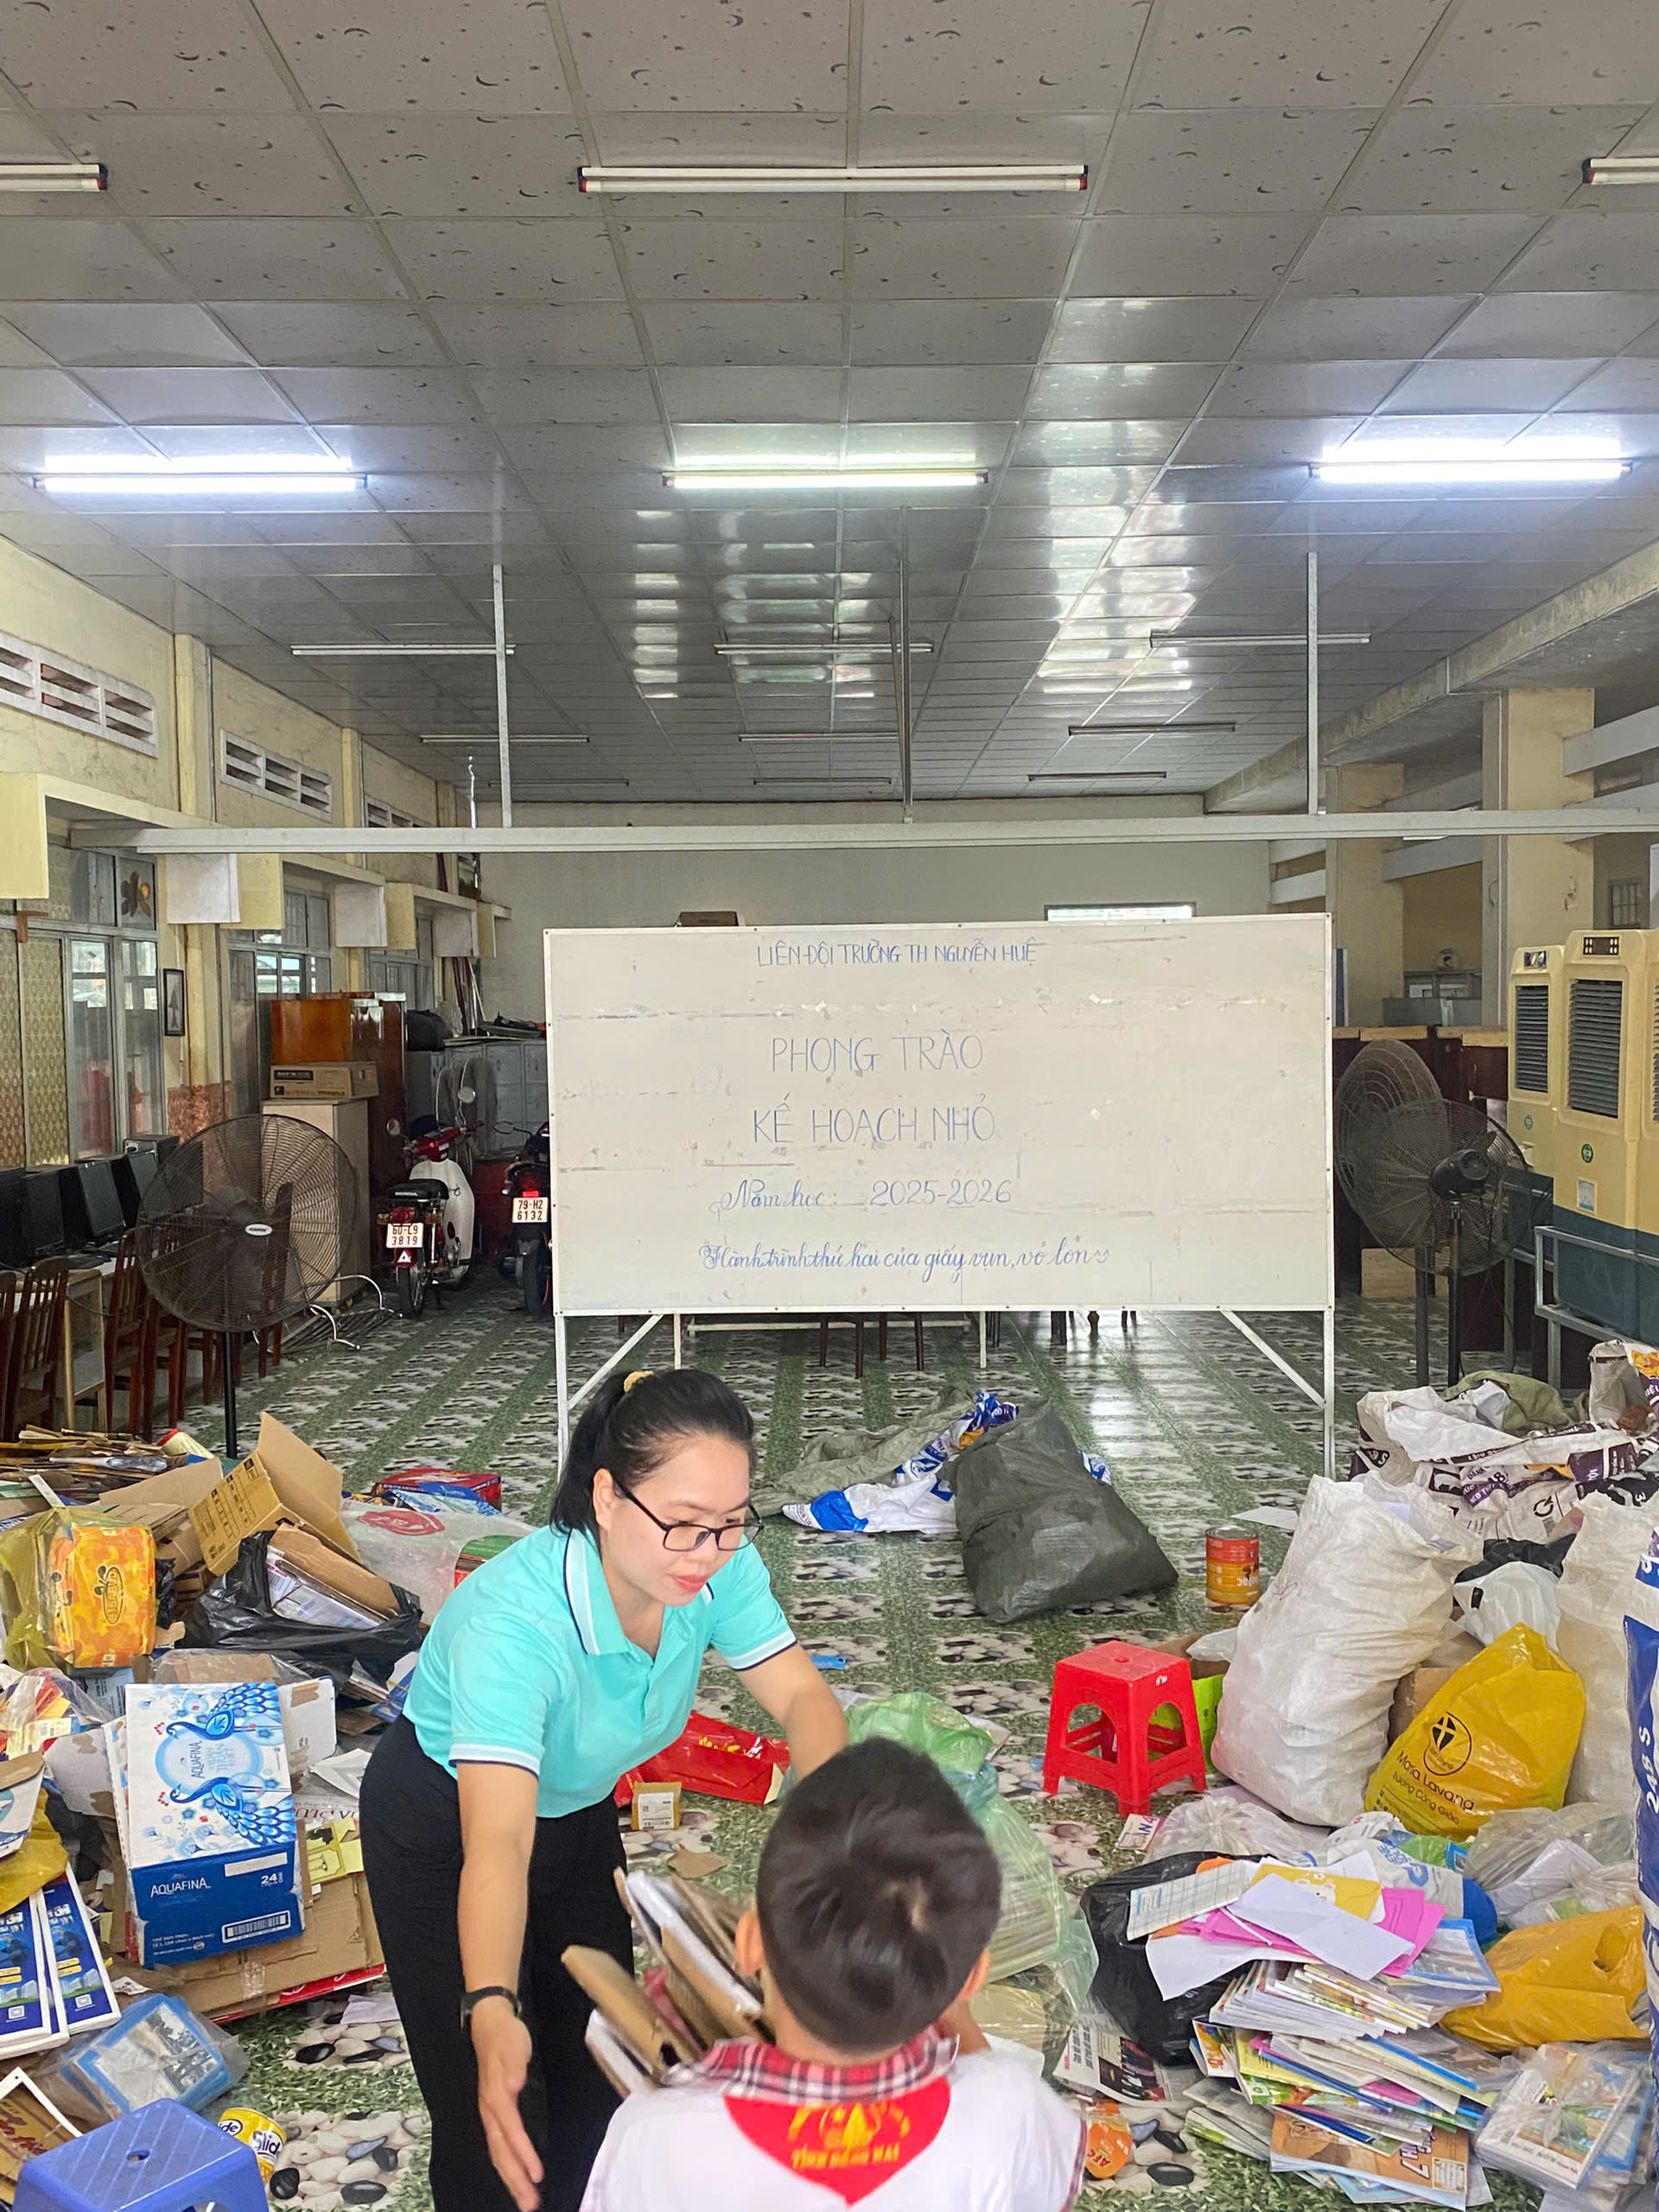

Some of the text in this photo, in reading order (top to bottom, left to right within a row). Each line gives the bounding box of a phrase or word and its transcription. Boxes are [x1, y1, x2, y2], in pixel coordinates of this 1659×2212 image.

[758, 940, 800, 966] LIÊN
[803, 941, 833, 967] ĐỘI
[836, 938, 903, 964] TRƯỜNG
[904, 944, 927, 963] TH
[935, 938, 995, 962] NGUYỄN
[772, 1028, 982, 1071] PHONG TRÀO
[753, 1091, 793, 1143] KẾ
[932, 1093, 995, 1141] NHỎ
[716, 1179, 781, 1211] Năm
[870, 1179, 1012, 1207] 2025-2026
[517, 1211, 543, 1221] 6132
[391, 1236, 417, 1246] 3819
[698, 1240, 762, 1270] Hành
[763, 1242, 808, 1268] trình
[808, 1242, 843, 1267] thứ
[844, 1242, 880, 1267] hai
[883, 1247, 920, 1267] của
[922, 1244, 965, 1283] giấy
[1016, 1242, 1046, 1266] vỏ
[188, 1740, 205, 1779] AQUAFINA
[1423, 1774, 1475, 1811] Lavang
[150, 1877, 212, 1898] AQUAFINA
[261, 1873, 278, 1885] 24
[1087, 2148, 1111, 2167] AFC
